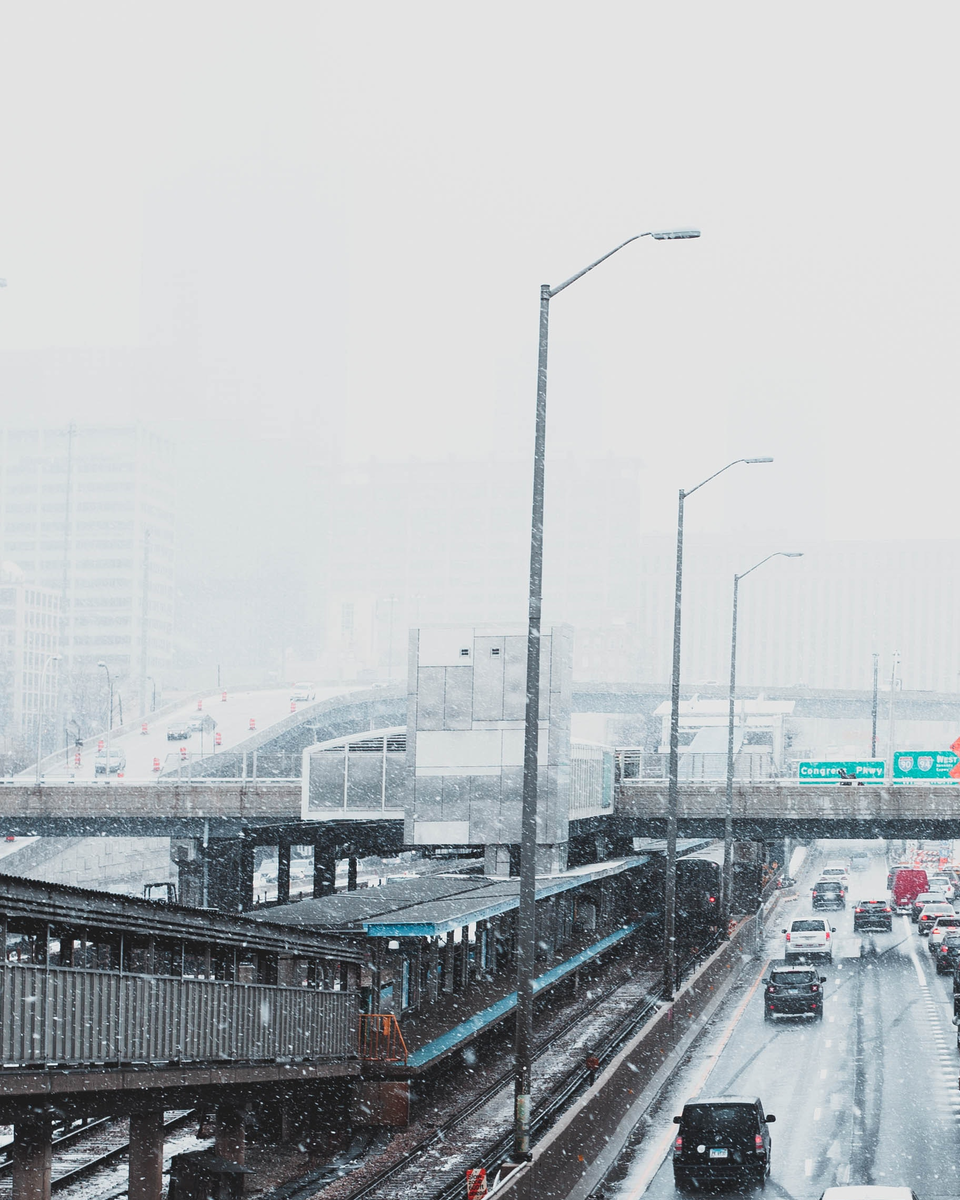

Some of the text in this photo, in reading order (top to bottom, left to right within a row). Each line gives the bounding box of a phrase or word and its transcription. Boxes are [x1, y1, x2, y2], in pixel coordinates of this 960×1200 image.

[936, 755, 958, 763] WEST
[901, 760, 912, 768] 90
[919, 760, 931, 768] 94
[856, 766, 883, 776] Pkwy
